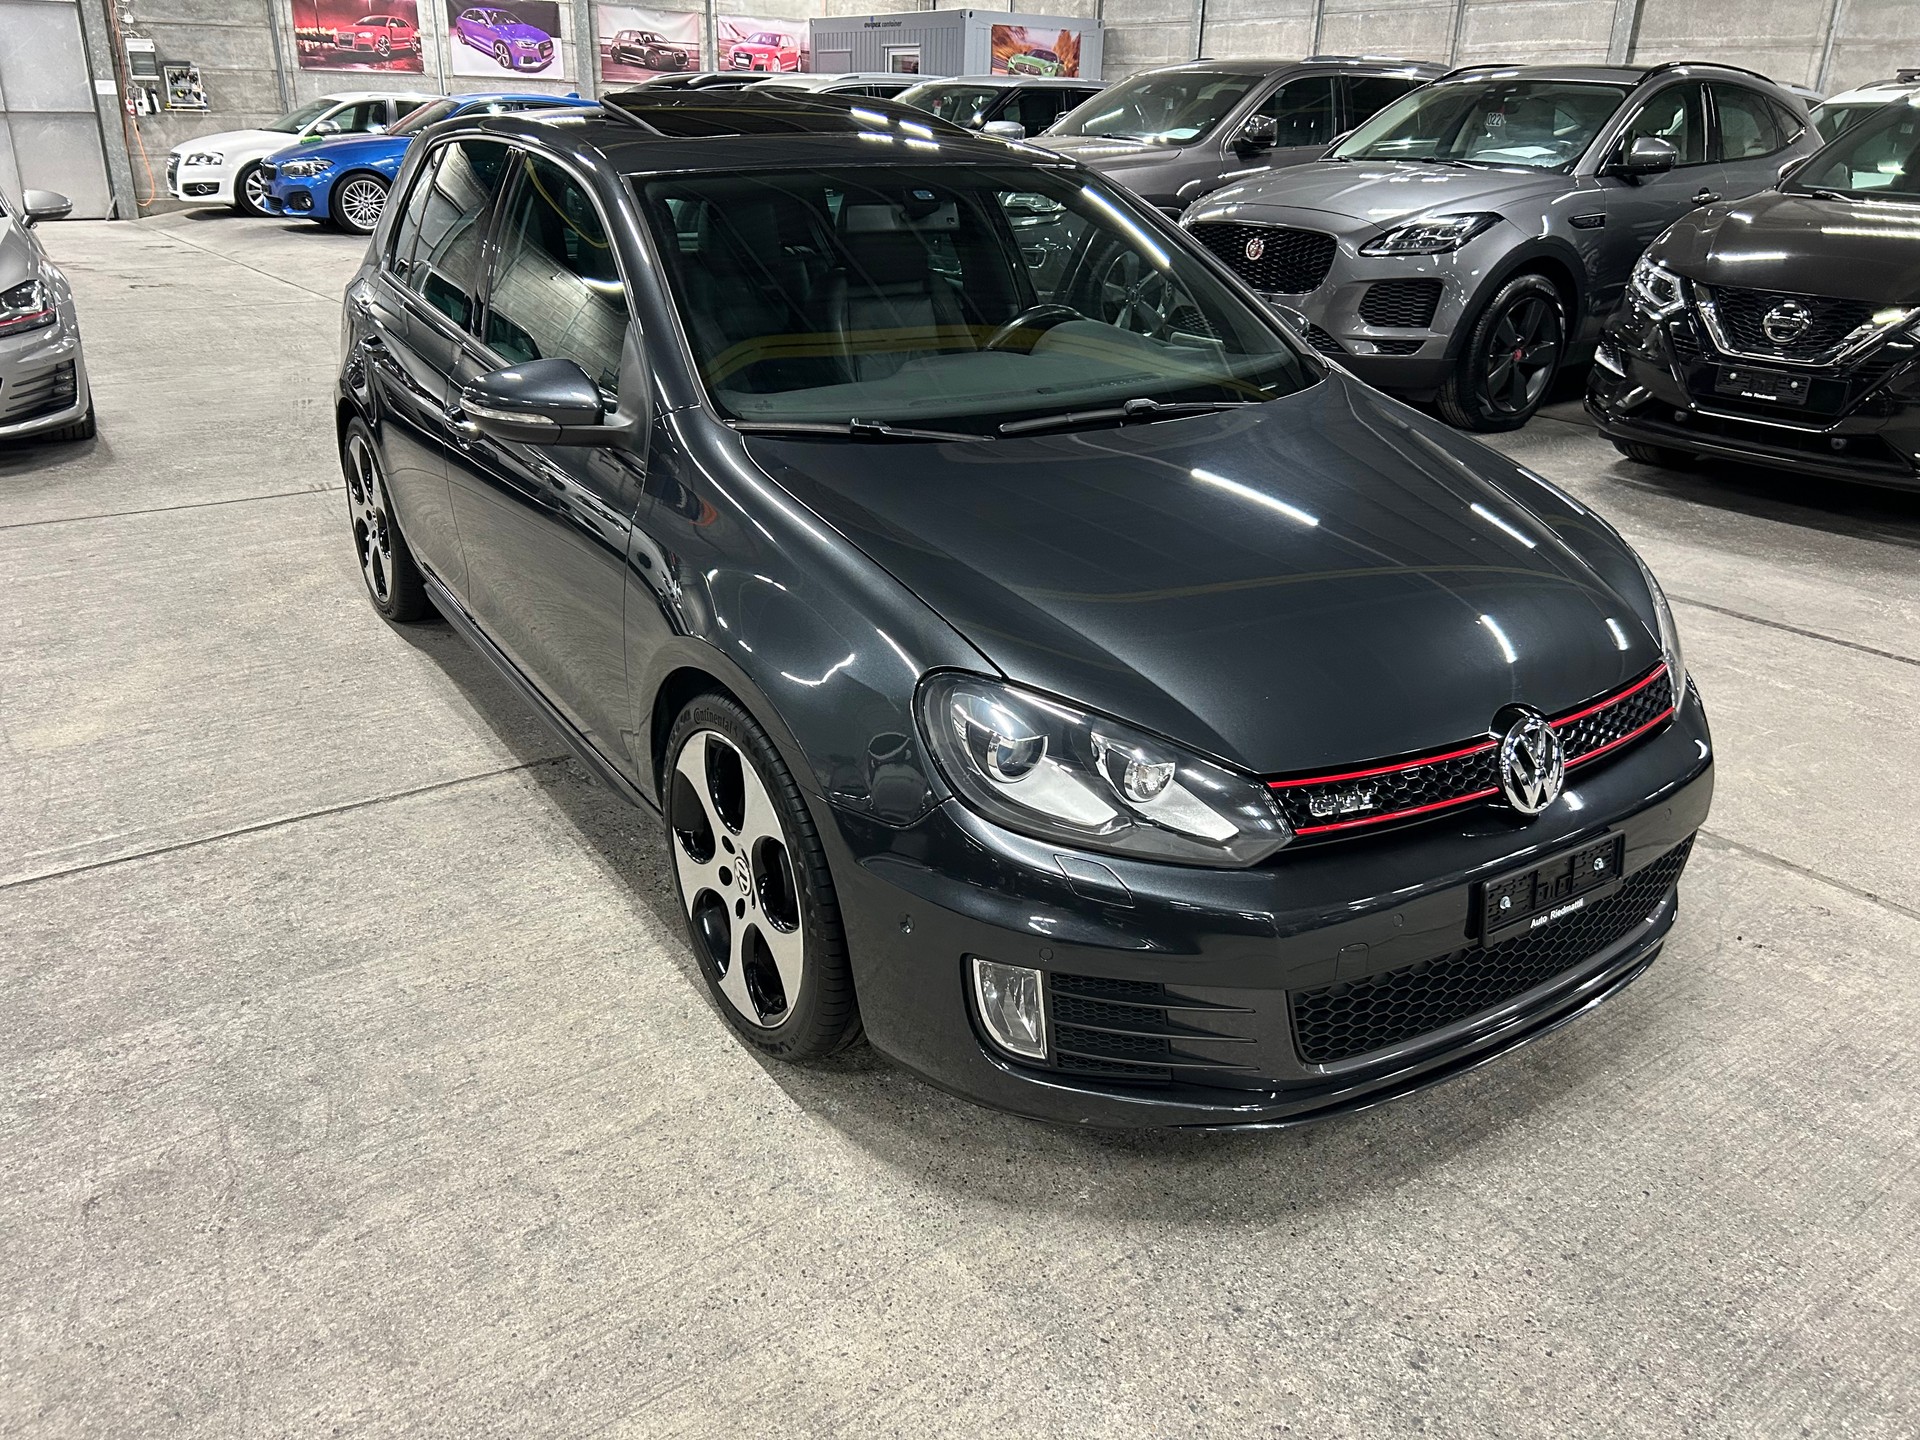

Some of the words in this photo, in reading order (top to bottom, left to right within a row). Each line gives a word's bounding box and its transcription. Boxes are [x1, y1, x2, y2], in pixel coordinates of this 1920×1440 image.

[693, 707, 732, 733] Continental
[1309, 792, 1374, 817] GTI
[1530, 915, 1548, 929] Auto
